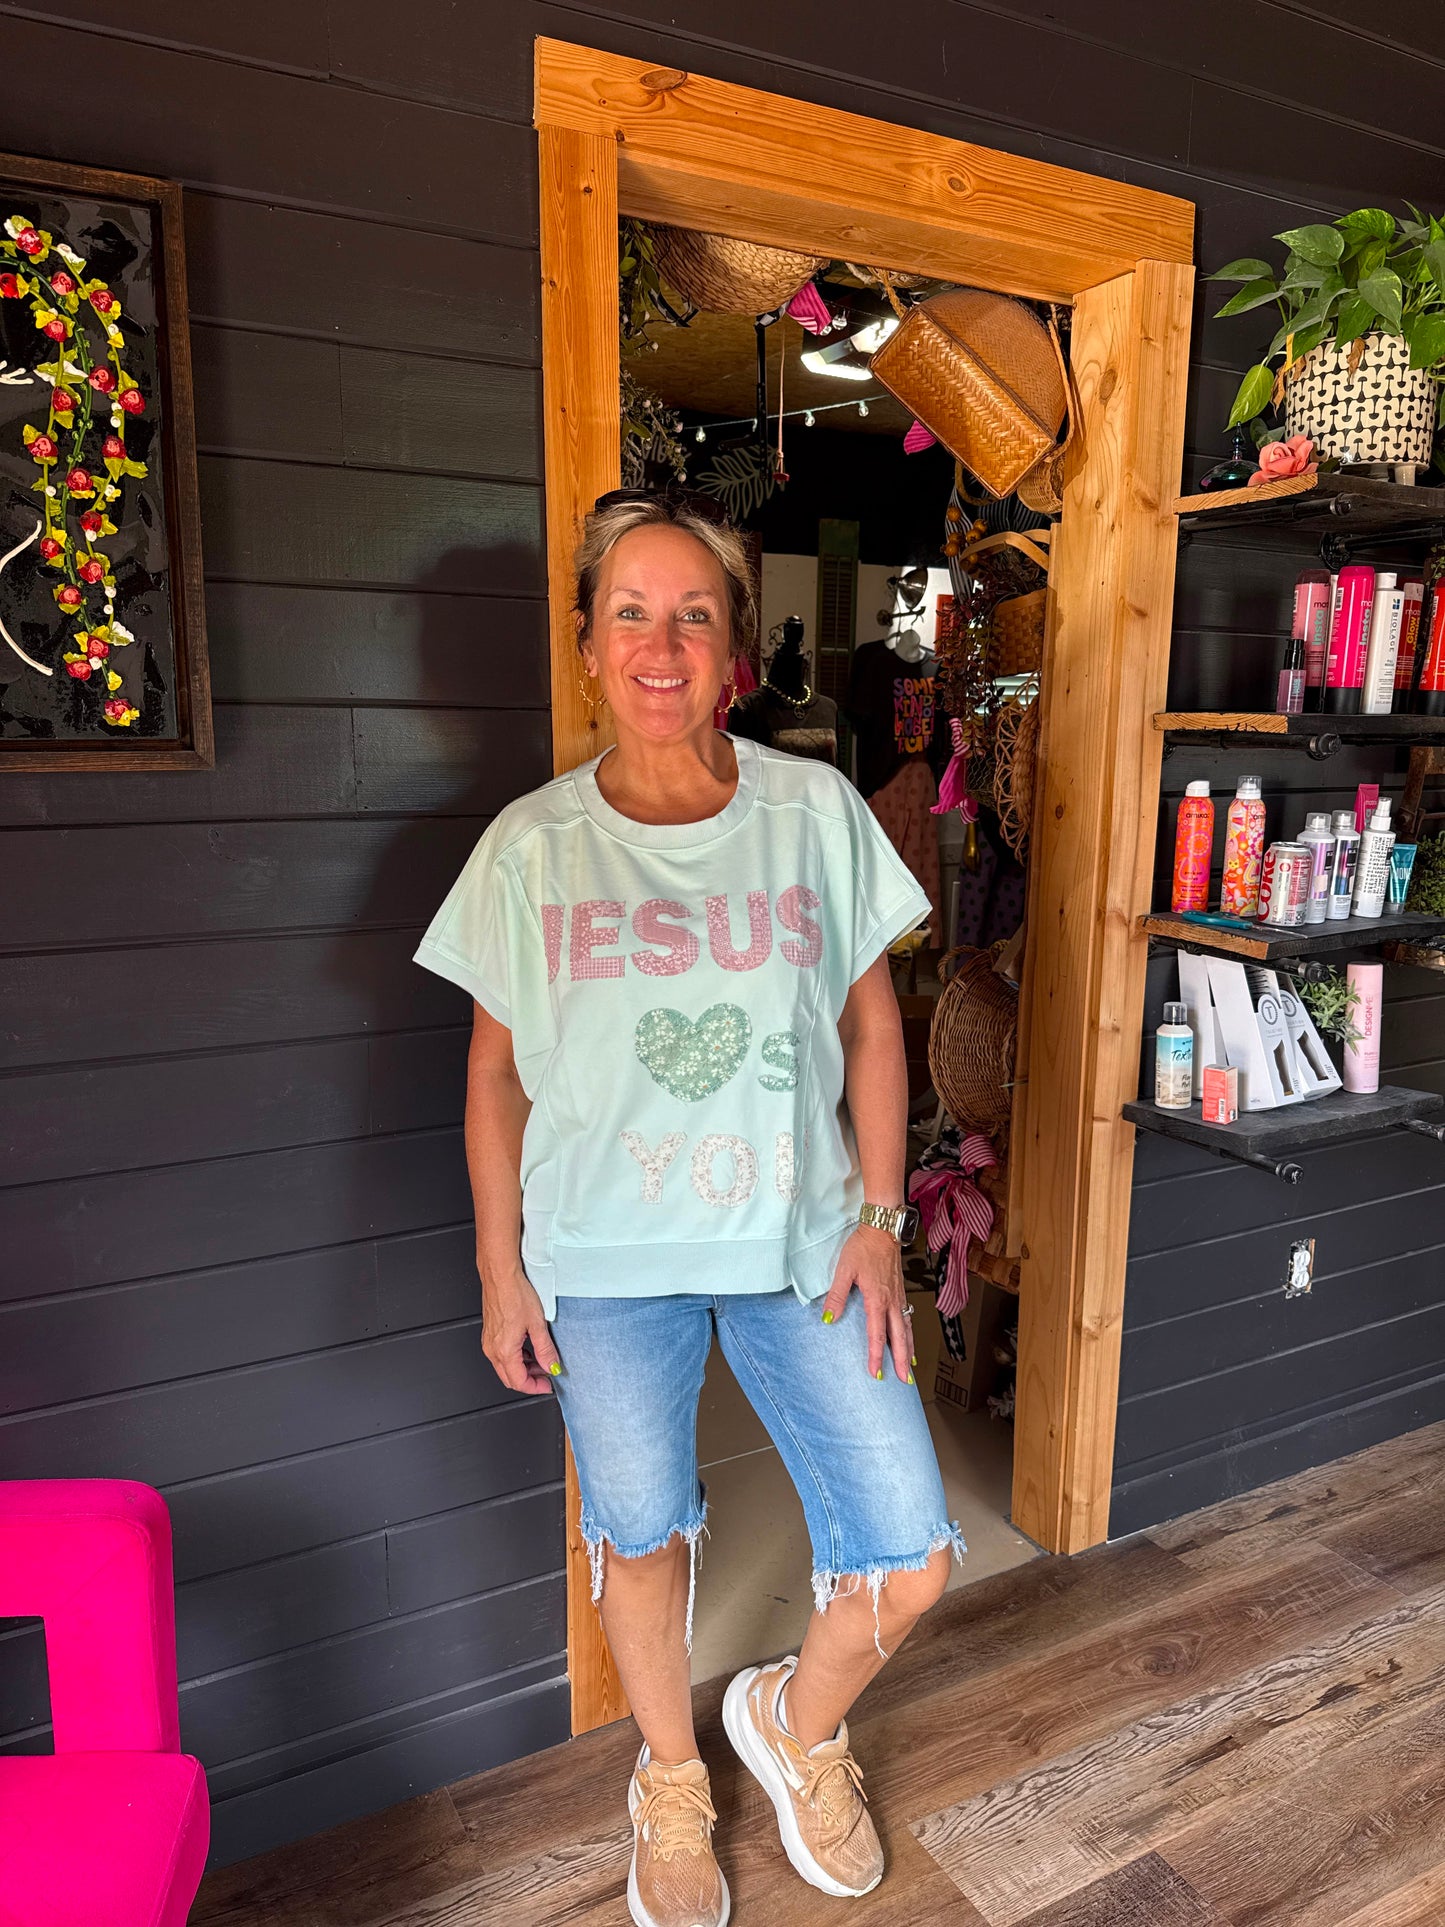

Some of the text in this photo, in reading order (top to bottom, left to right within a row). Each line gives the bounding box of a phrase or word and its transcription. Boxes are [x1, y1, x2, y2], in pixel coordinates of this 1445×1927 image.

[1388, 612, 1399, 652] BIOLAGE
[1406, 616, 1416, 644] Glow
[1257, 851, 1276, 922] Coke
